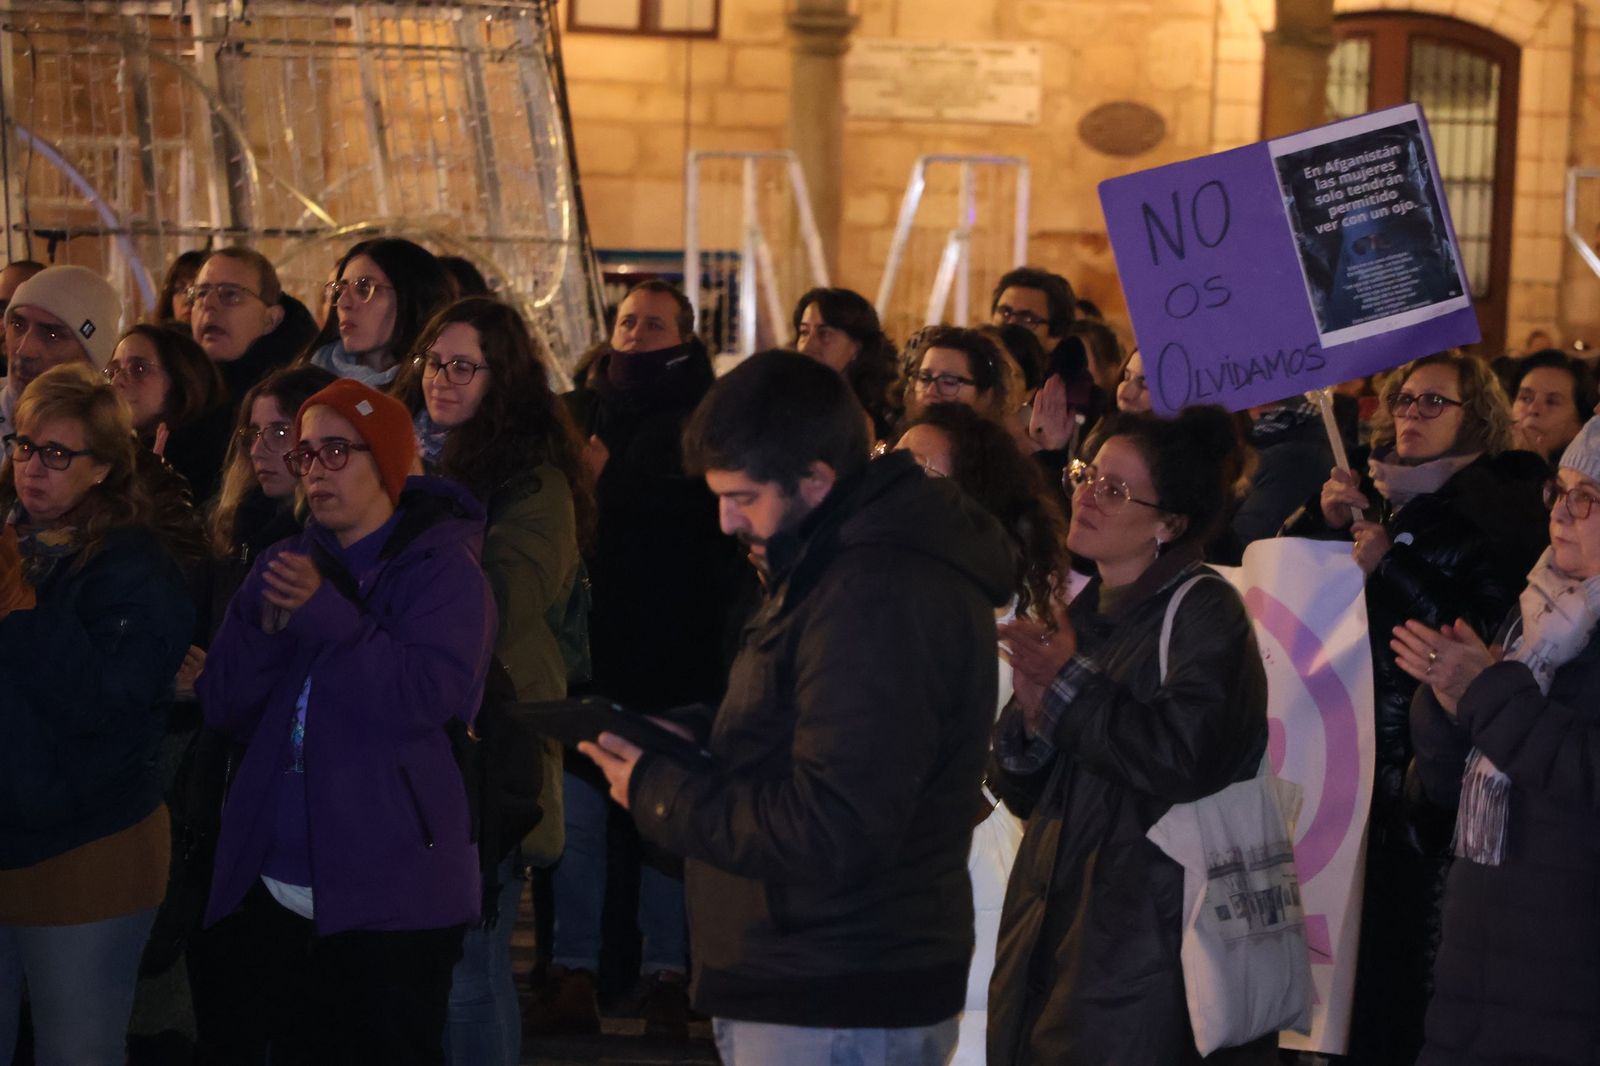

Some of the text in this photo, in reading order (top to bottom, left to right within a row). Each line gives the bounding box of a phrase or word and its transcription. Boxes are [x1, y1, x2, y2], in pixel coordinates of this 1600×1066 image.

[1303, 145, 1402, 179] En Afganistán
[1314, 160, 1397, 191] las mujeres
[1314, 173, 1404, 206] solo tendrán
[1327, 189, 1399, 220] permitido
[1141, 179, 1231, 267] NO
[1314, 200, 1419, 234] ver con un ojo.
